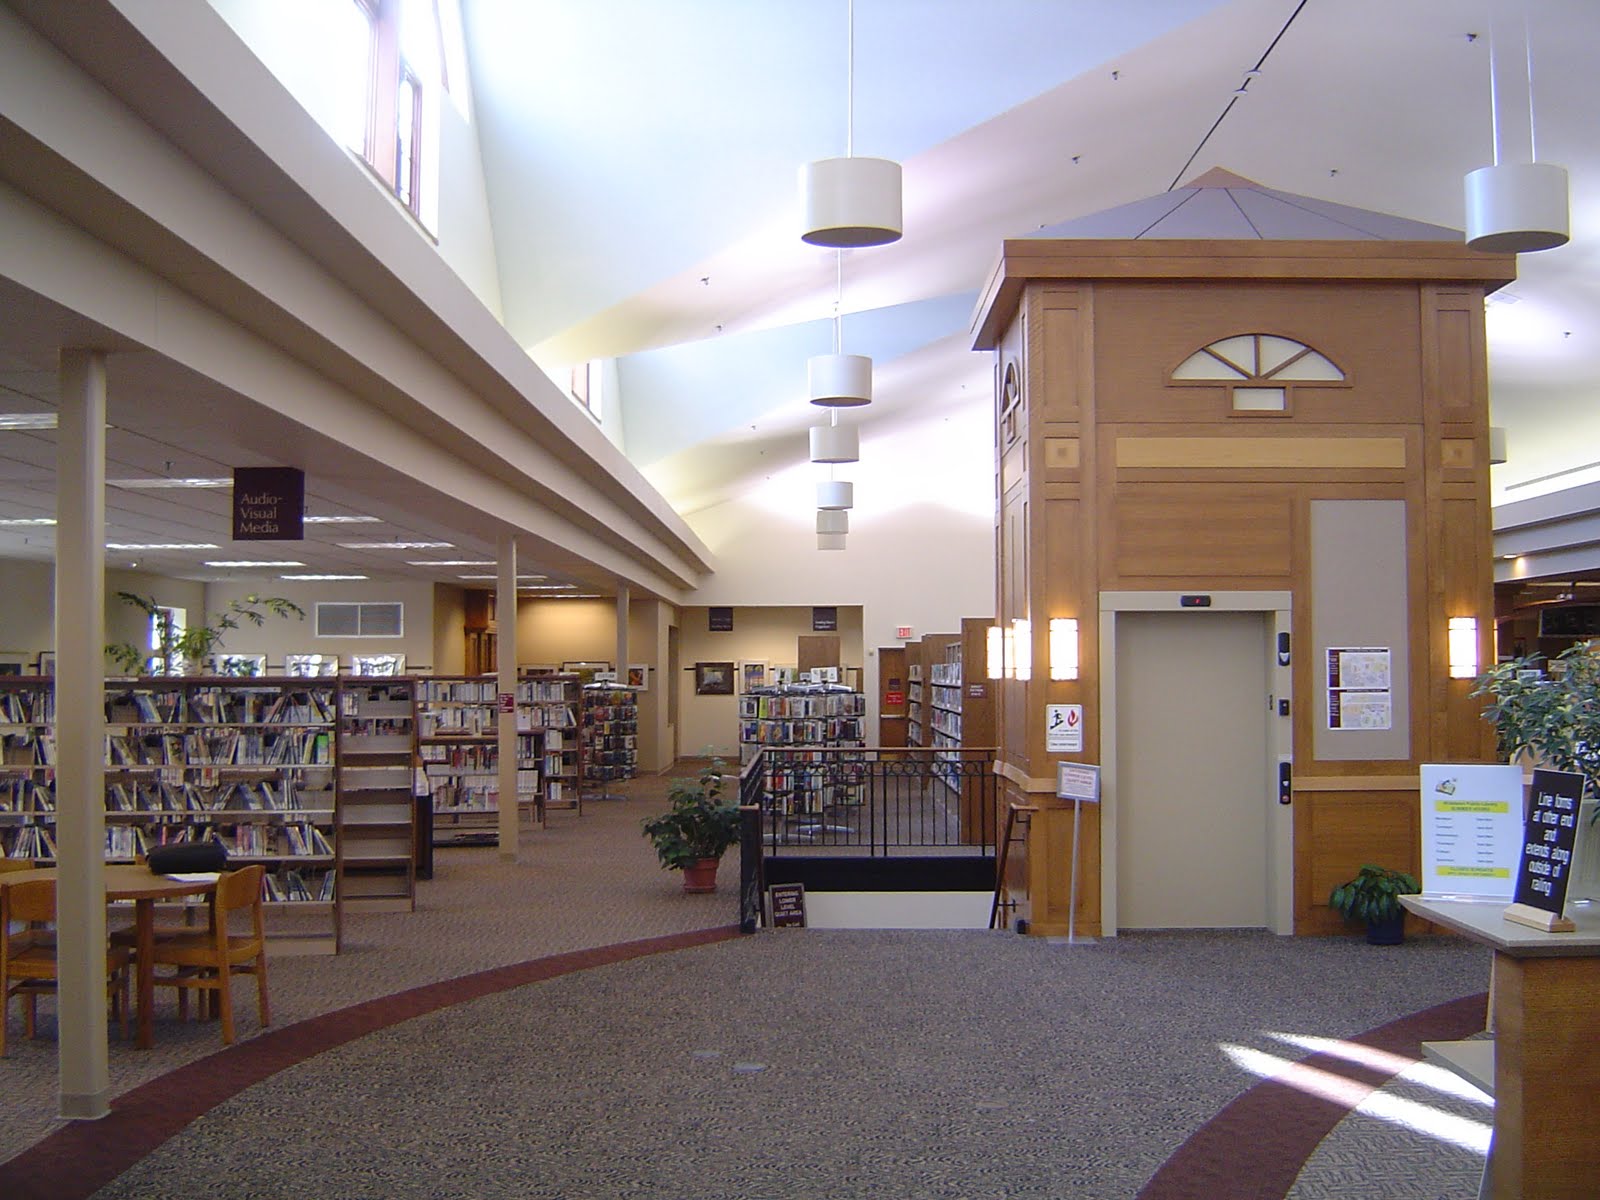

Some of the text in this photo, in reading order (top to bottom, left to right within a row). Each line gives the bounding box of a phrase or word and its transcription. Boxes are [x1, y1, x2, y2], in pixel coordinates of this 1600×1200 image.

[241, 492, 283, 505] Audio-
[241, 507, 277, 519] Visual
[240, 521, 279, 534] Media
[1538, 792, 1573, 810] Line forms
[1532, 809, 1574, 827] at other end
[1544, 828, 1557, 842] and
[1526, 843, 1570, 865] extends along
[1529, 861, 1561, 878] outside of
